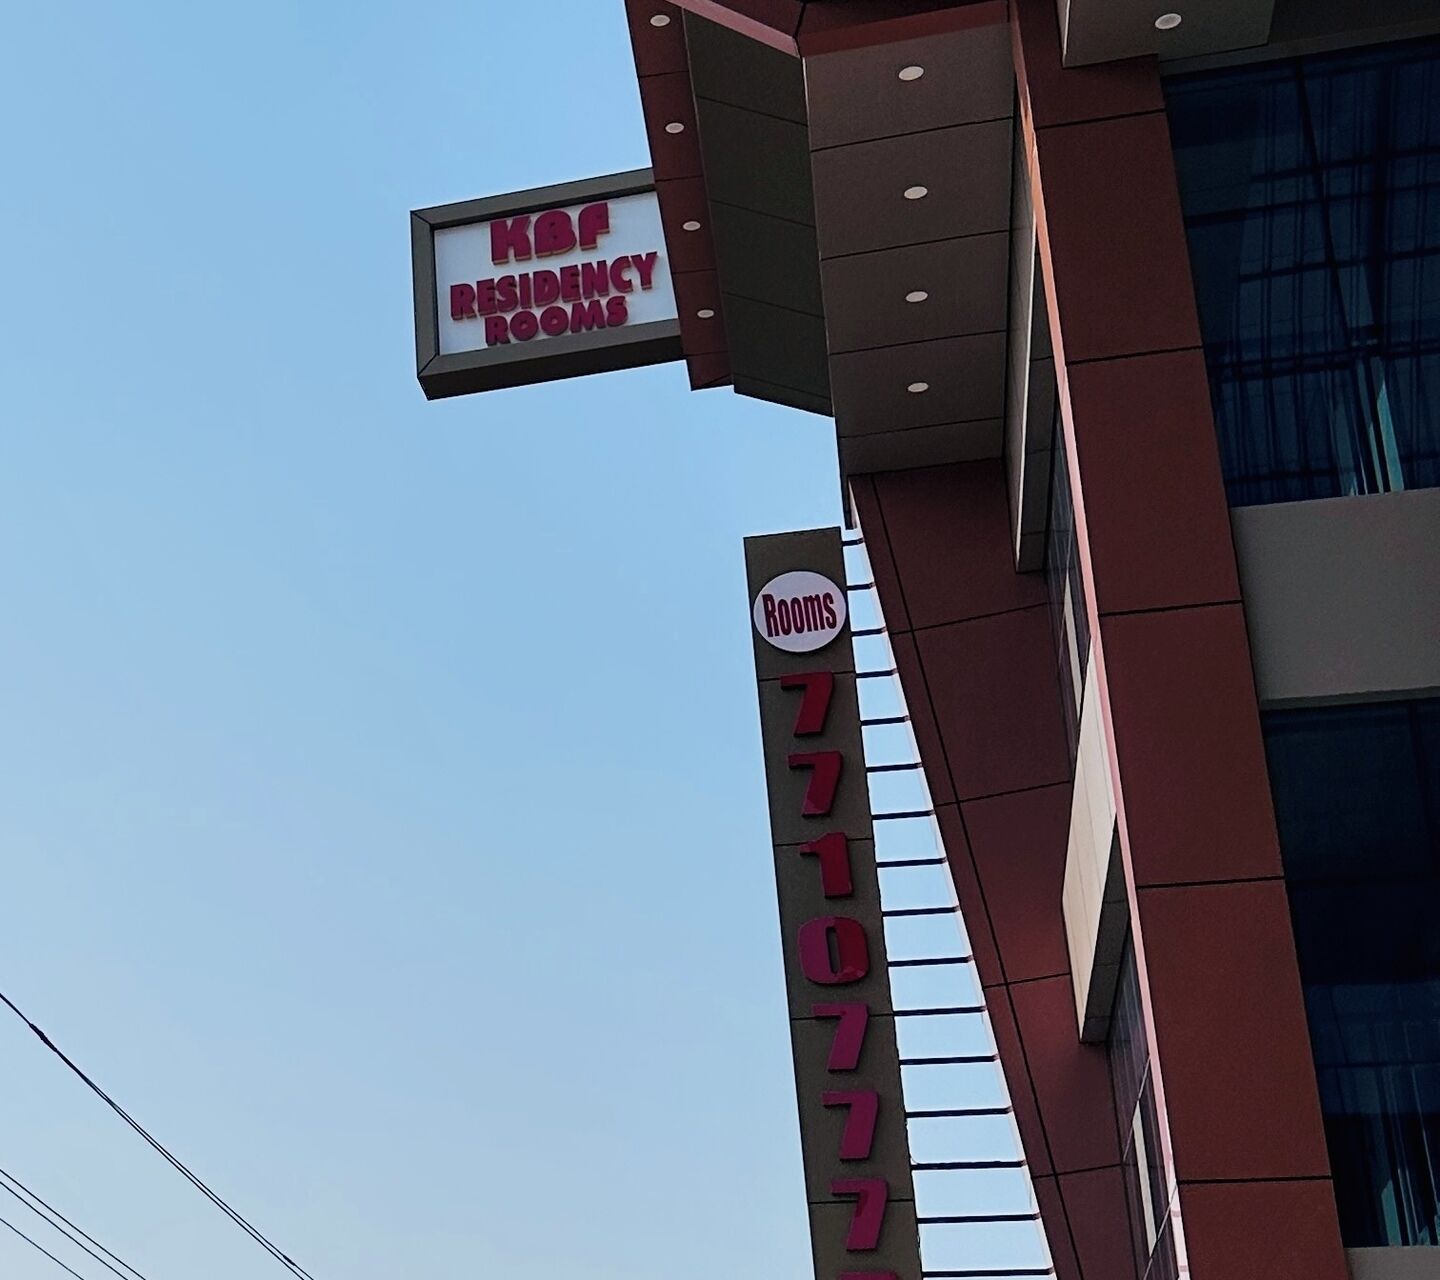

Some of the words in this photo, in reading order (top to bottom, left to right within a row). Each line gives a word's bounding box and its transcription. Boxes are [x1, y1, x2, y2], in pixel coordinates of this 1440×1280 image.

[490, 202, 610, 266] KBF
[450, 251, 658, 320] RESIDENCY
[484, 295, 628, 347] ROOMS
[762, 592, 837, 637] Rooms
